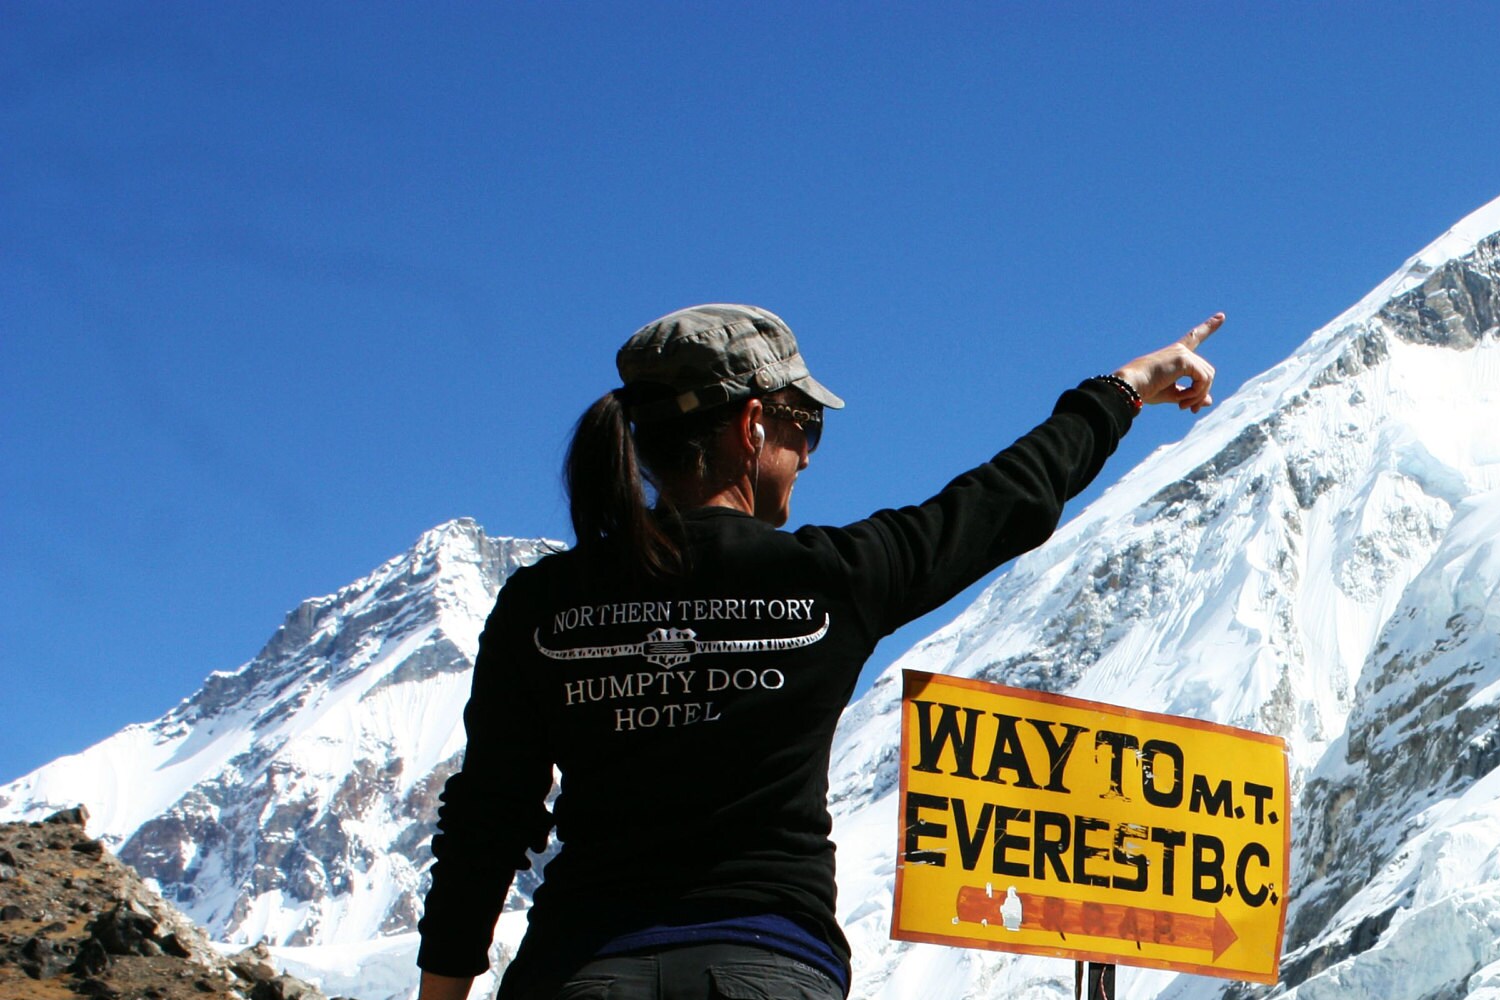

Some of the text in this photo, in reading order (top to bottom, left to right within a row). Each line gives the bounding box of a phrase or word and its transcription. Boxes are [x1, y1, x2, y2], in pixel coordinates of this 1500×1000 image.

[553, 599, 814, 634] NORTHERN TERRITORY
[565, 668, 785, 705] HUMPTY DOO
[615, 702, 721, 732] HOTEL
[911, 699, 1090, 794] WAY
[1094, 730, 1184, 808] TO
[904, 791, 1187, 896] EVEREST
